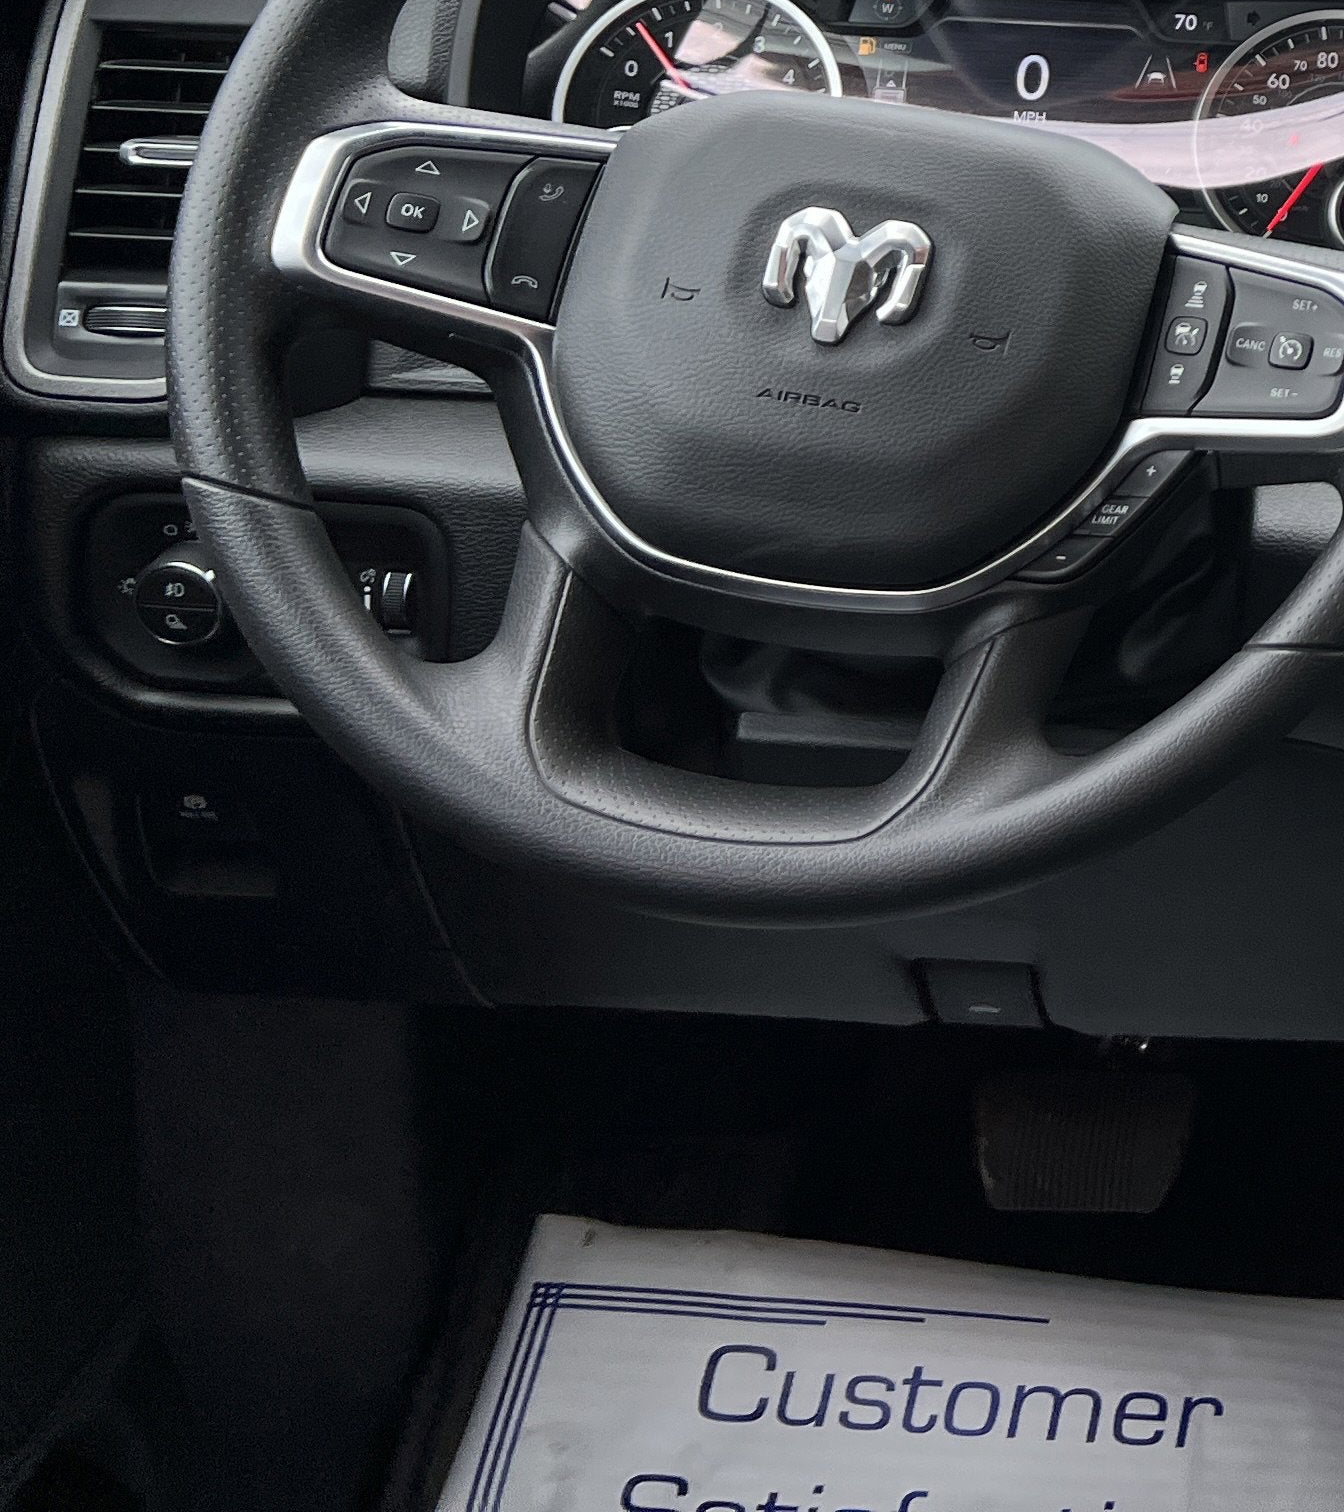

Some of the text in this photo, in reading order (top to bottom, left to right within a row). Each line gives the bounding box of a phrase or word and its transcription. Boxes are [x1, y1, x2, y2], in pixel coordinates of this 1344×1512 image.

[1174, 14, 1198, 31] 70
[664, 31, 673, 48] 1
[753, 36, 765, 53] 3
[624, 60, 638, 76] 0
[1294, 60, 1308, 71] 70
[1317, 52, 1339, 69] 80
[783, 69, 795, 85] 4
[1016, 54, 1050, 101] 0
[1267, 73, 1290, 90] 60
[613, 90, 641, 101] RPM
[1252, 94, 1268, 105] 50
[1012, 109, 1047, 123] MPH
[1240, 120, 1264, 133] 40
[1256, 193, 1269, 203] 10
[401, 204, 425, 220] OK
[1235, 338, 1266, 352] CANC
[1323, 347, 1342, 359] RES
[756, 388, 862, 413] AIRBAG
[1102, 504, 1130, 515] GEAR
[1091, 515, 1120, 526] LIMIT
[698, 1344, 1222, 1449] Customer
